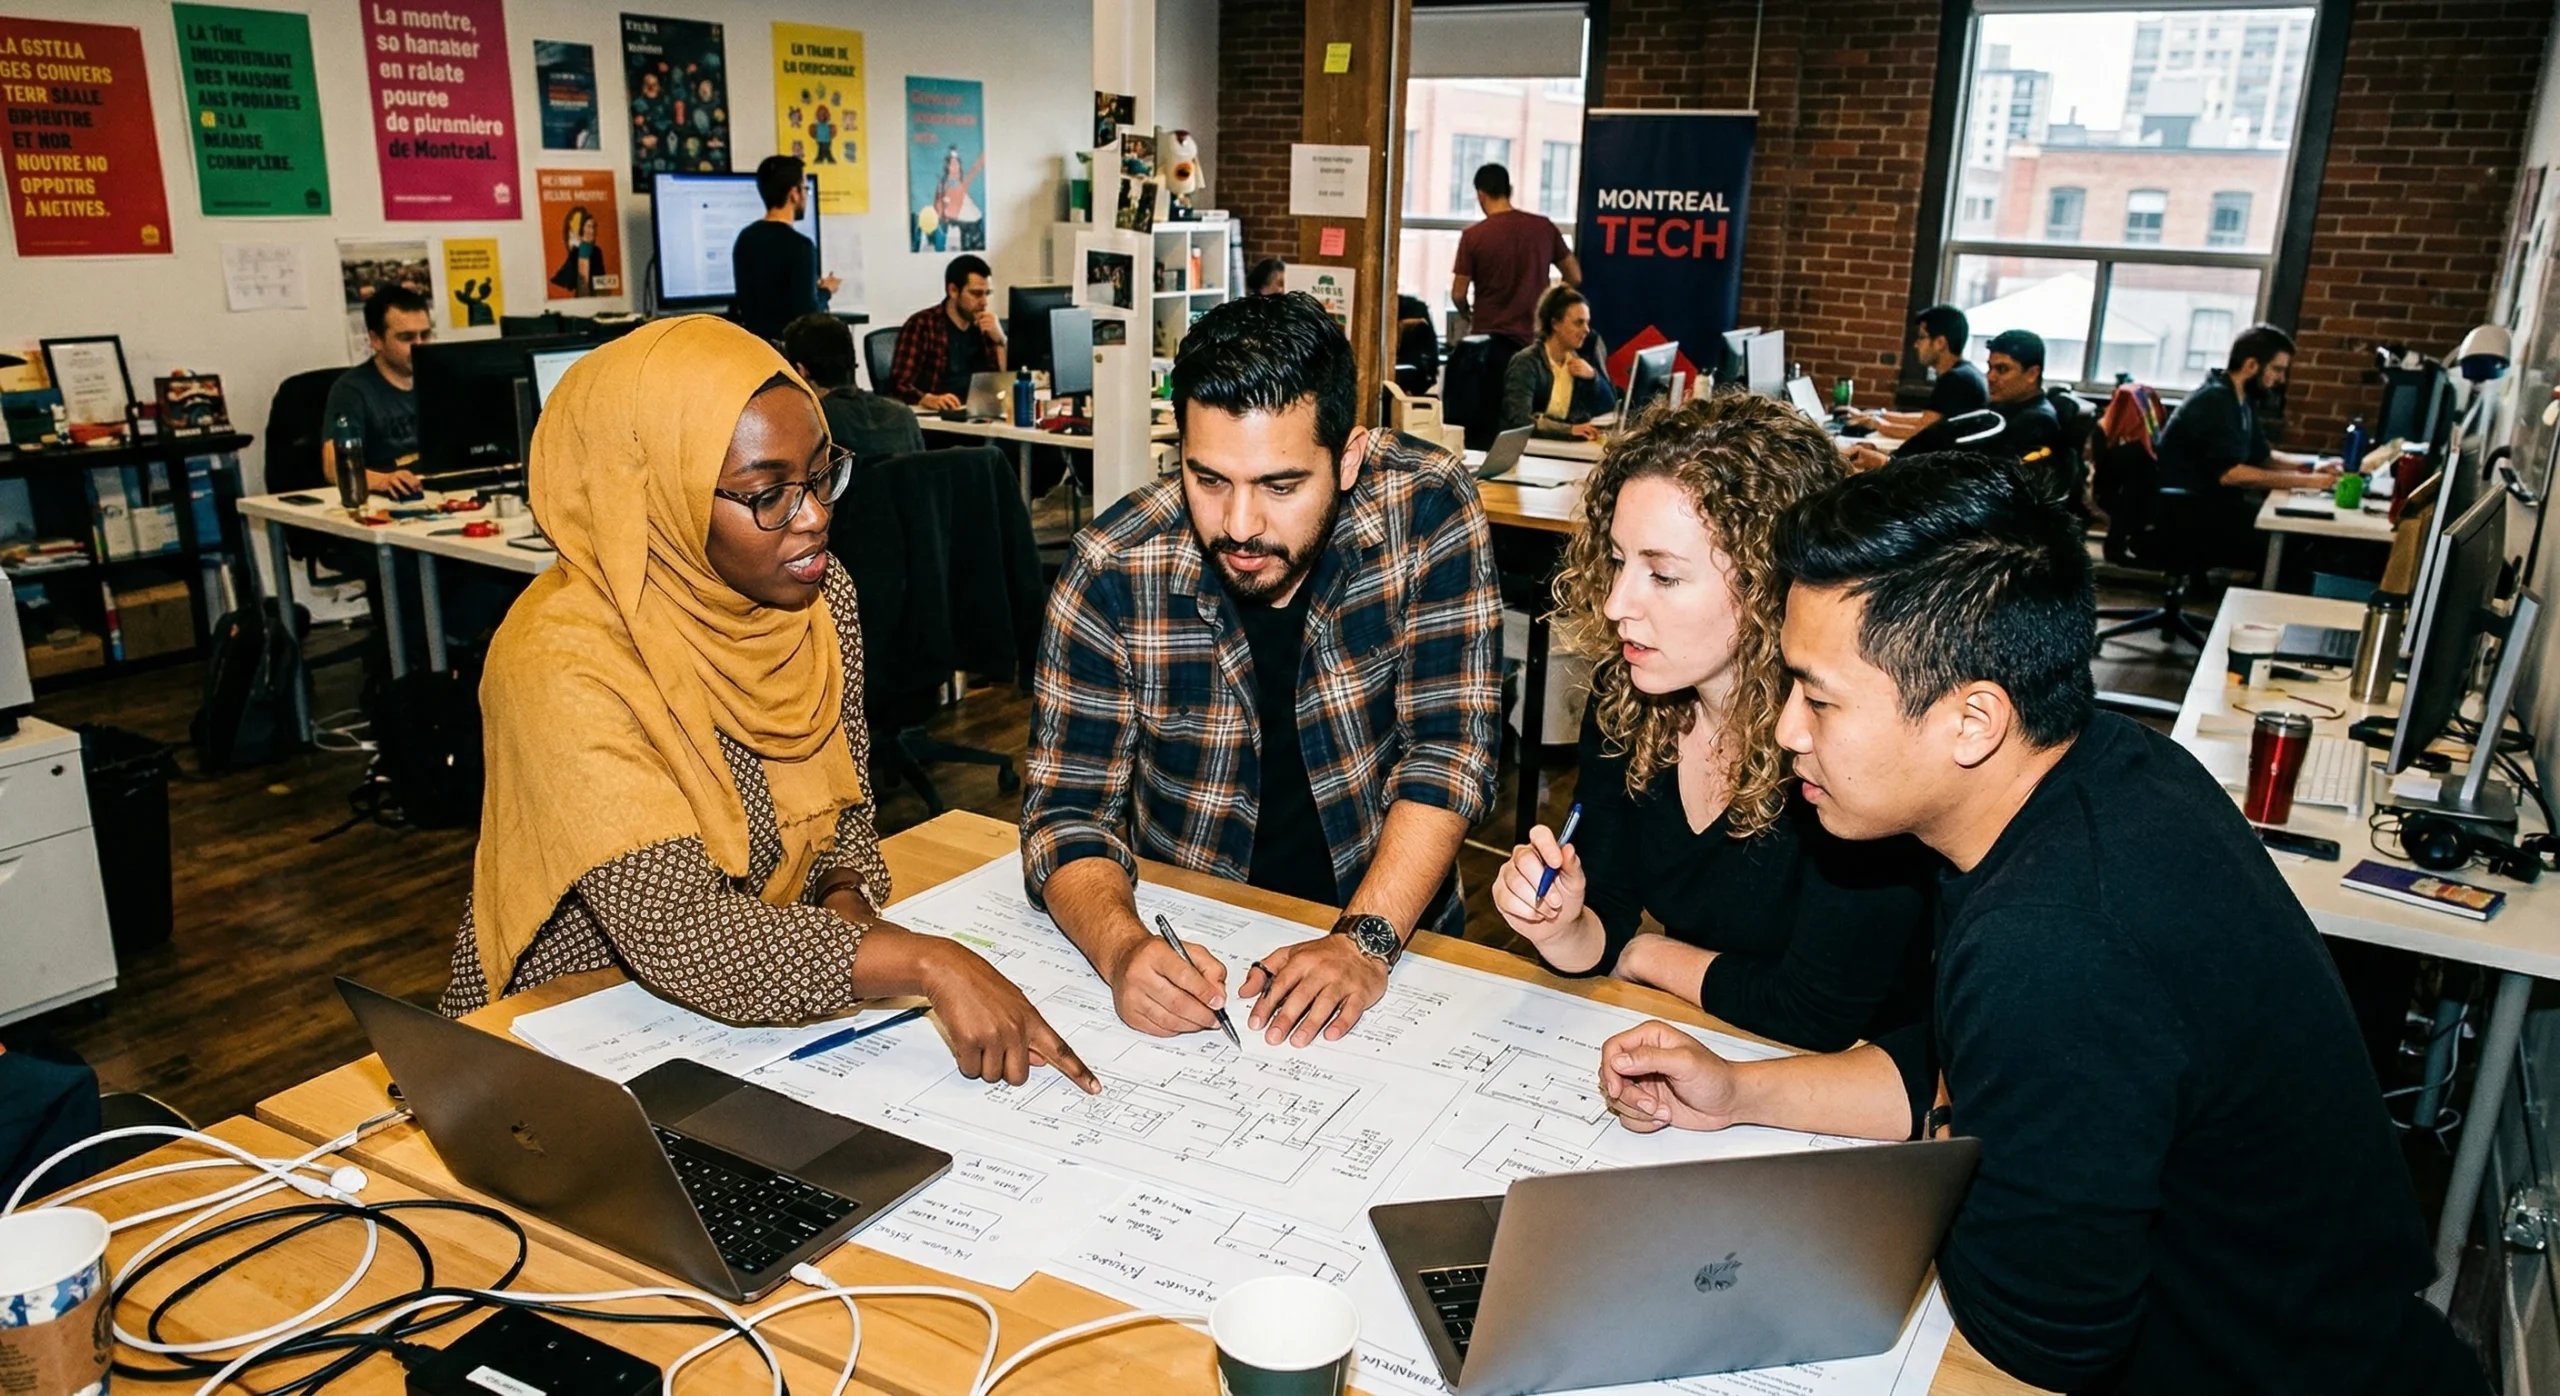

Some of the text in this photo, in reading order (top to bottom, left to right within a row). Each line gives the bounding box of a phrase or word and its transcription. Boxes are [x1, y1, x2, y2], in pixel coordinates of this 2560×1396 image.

[373, 3, 477, 36] La montre,
[376, 34, 399, 52] so
[379, 62, 403, 79] en
[12, 131, 32, 149] ET
[389, 137, 497, 160] de Montreal.
[1597, 188, 1731, 213] MONTREAL
[1596, 215, 1728, 260] TECH
